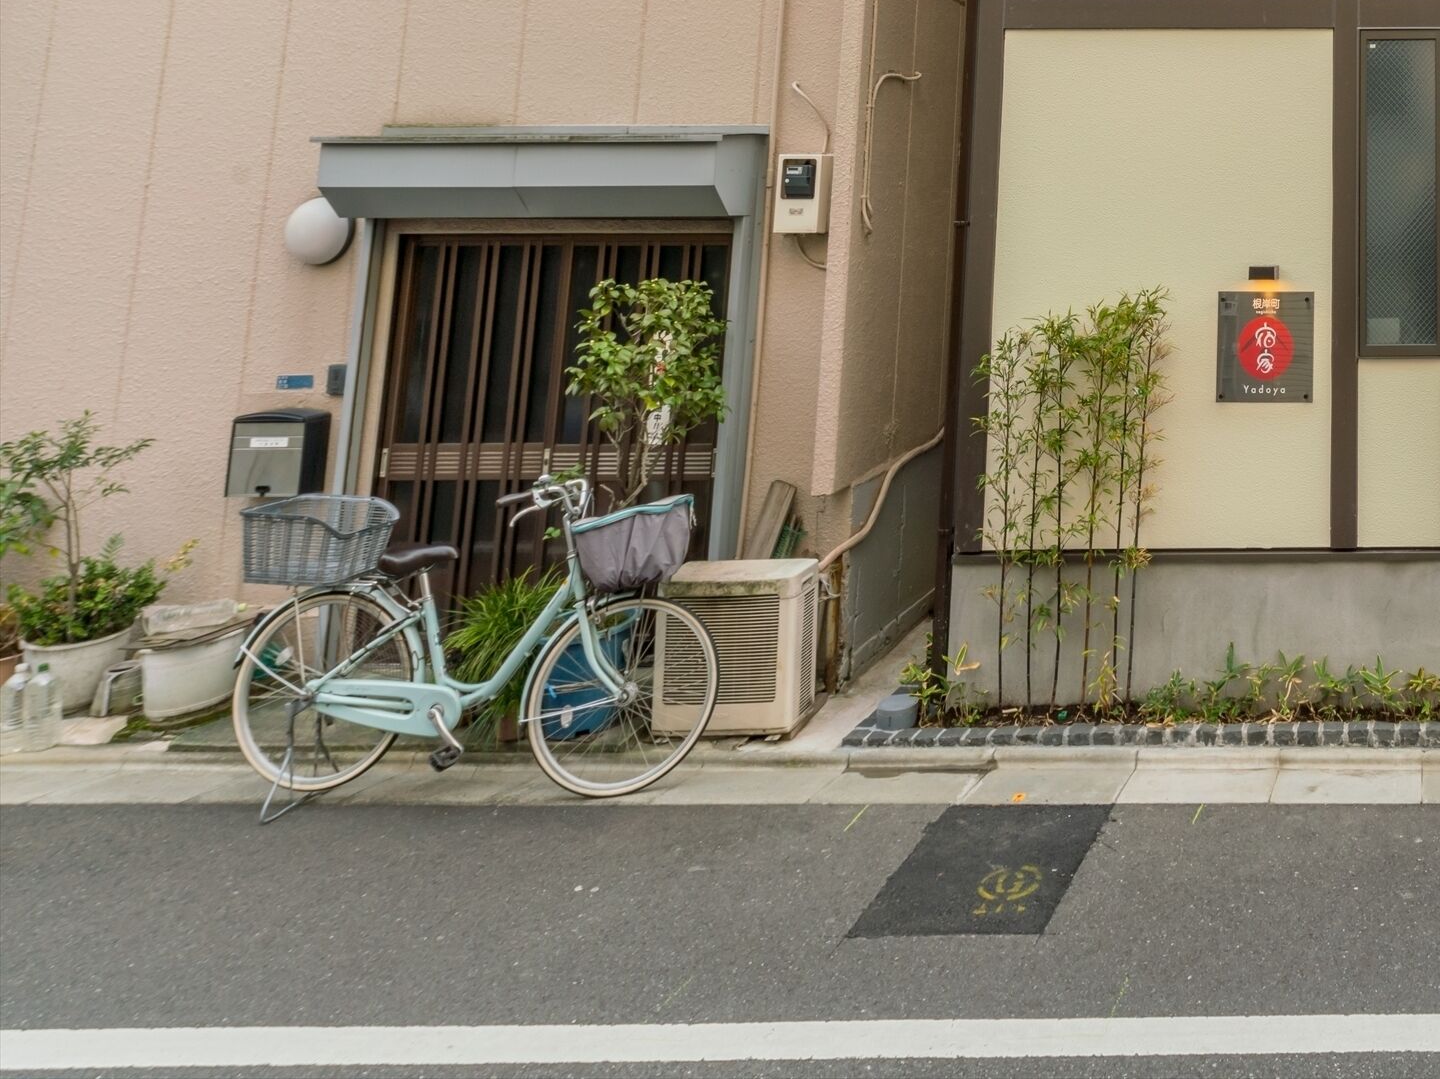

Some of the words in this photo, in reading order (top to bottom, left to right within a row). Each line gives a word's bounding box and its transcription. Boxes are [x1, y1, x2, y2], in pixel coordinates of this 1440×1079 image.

[1252, 298, 1280, 309] 根岸町
[1244, 385, 1286, 396] Yadoya
